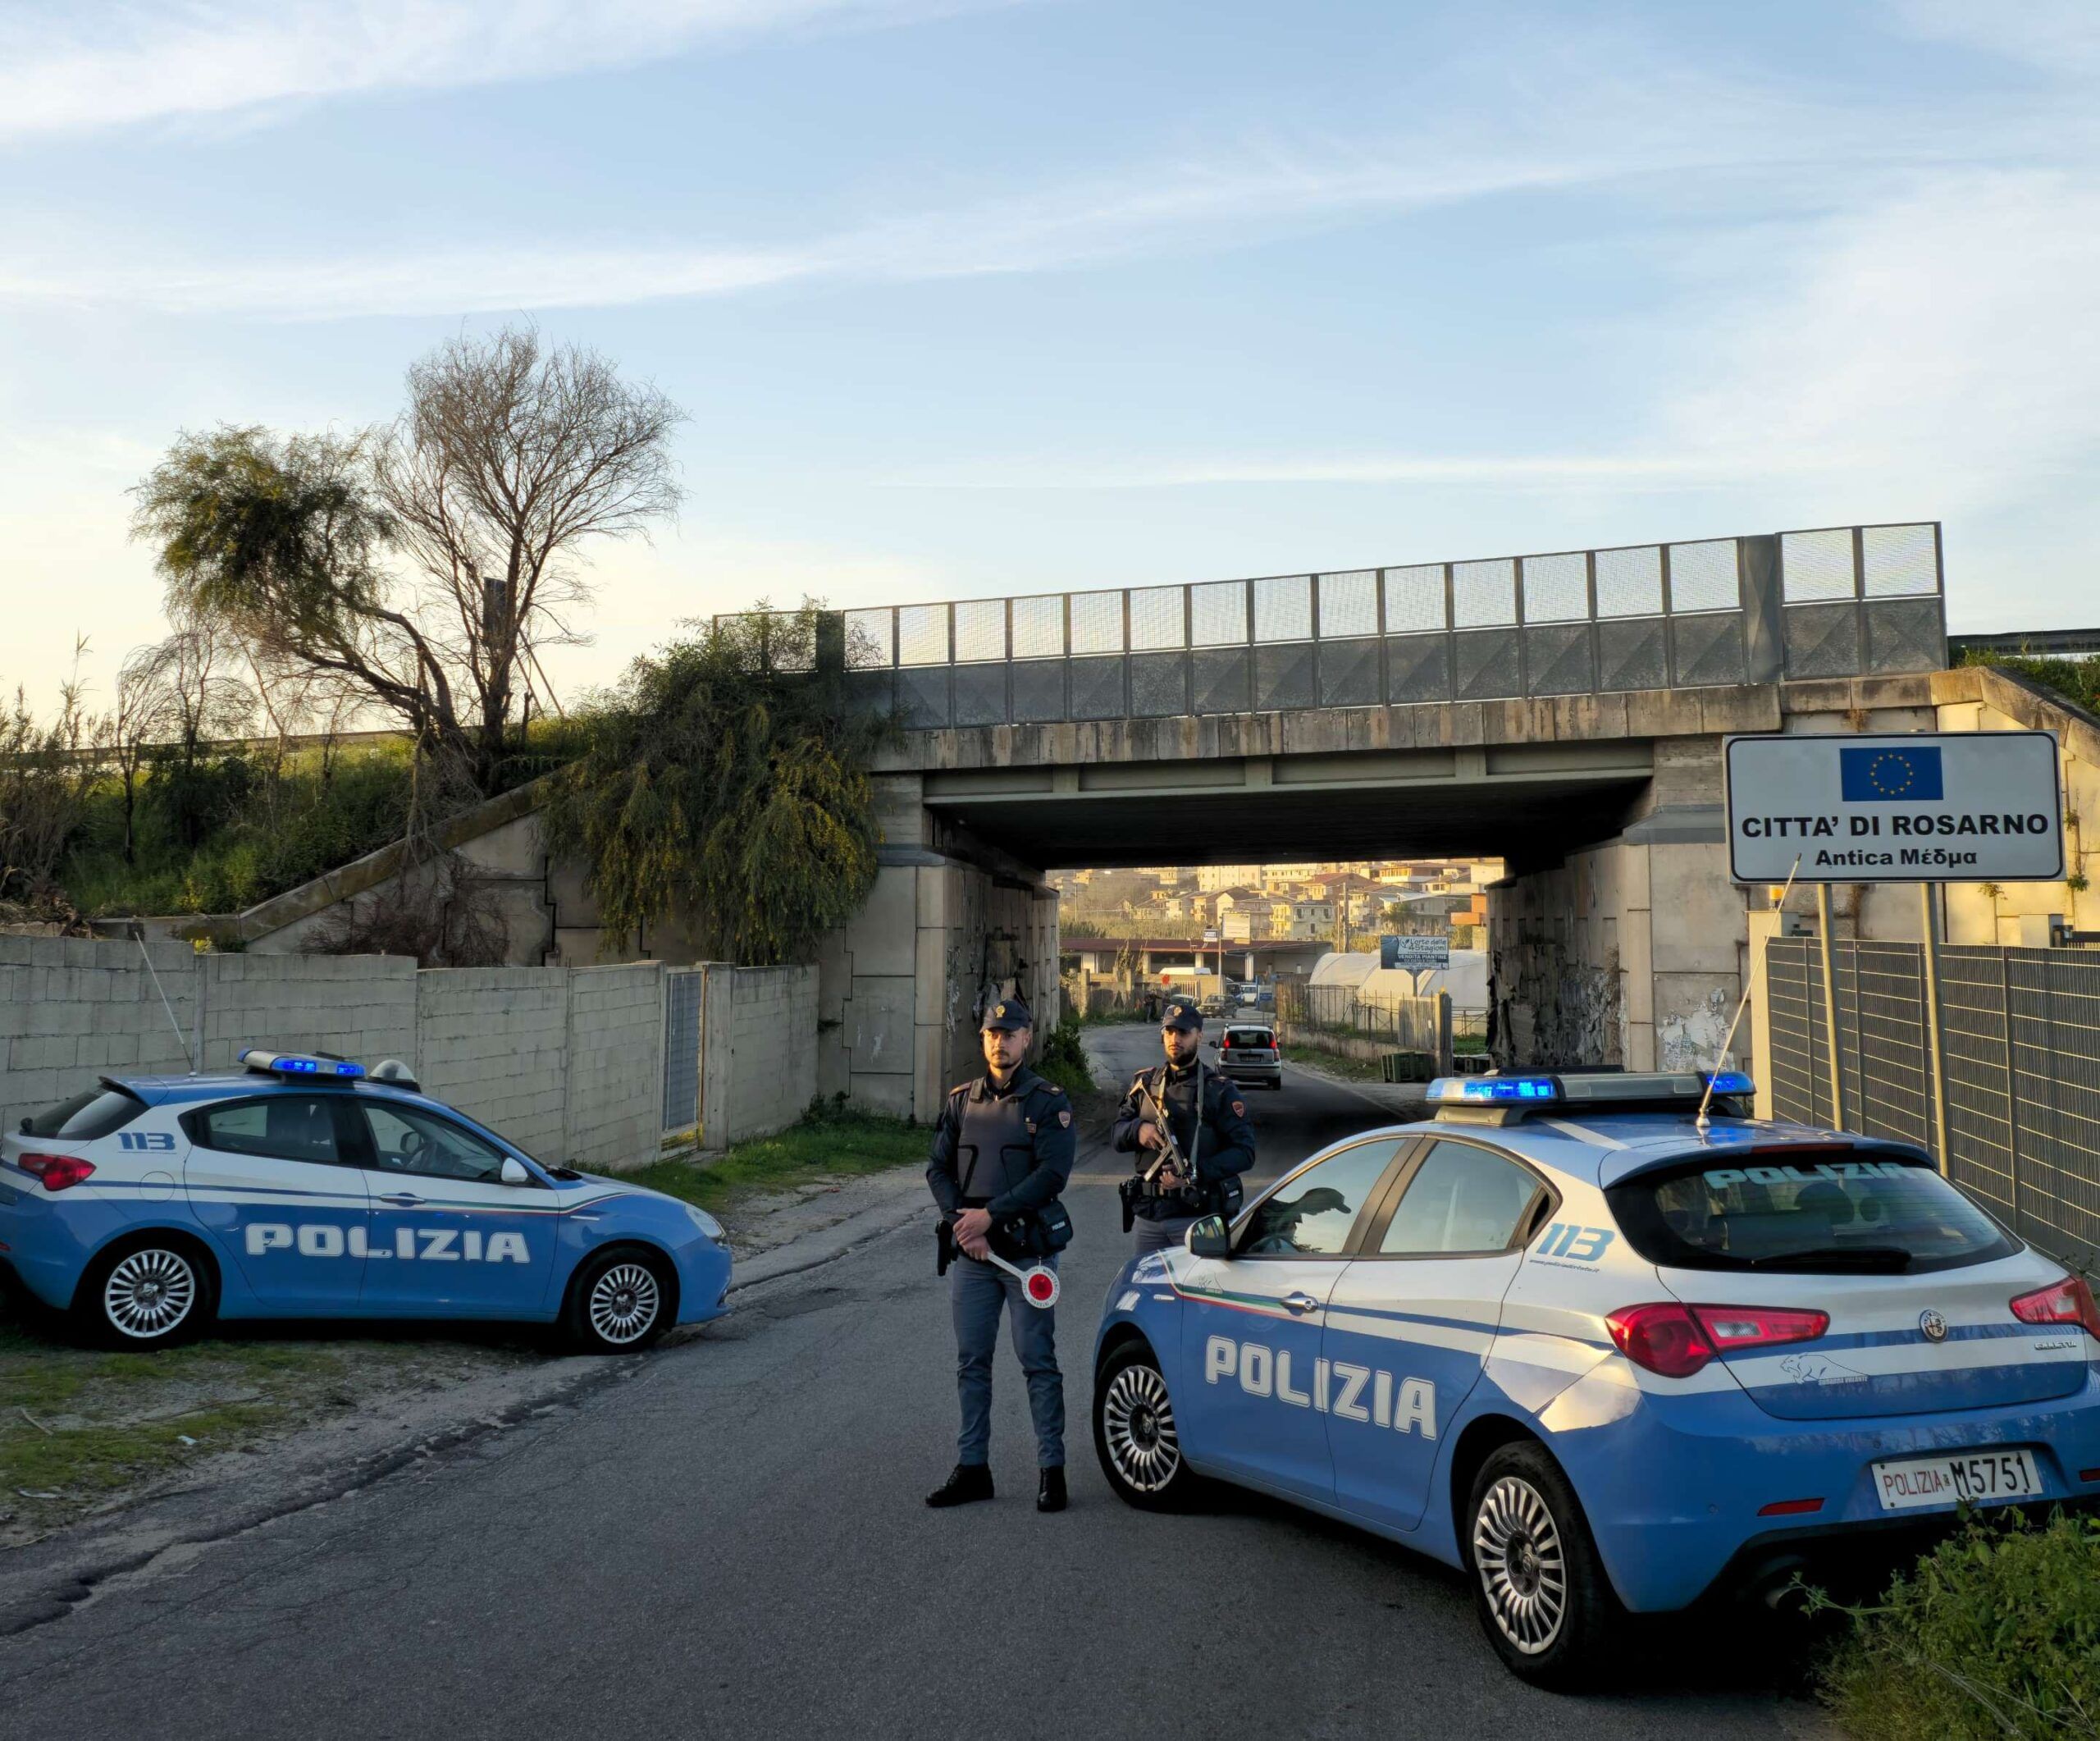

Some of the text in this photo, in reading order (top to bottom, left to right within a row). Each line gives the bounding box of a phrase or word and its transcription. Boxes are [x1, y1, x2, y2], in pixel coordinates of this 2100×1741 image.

[1850, 816, 1880, 836] DI
[1892, 813, 2049, 835] ROSARNO
[1815, 849, 1893, 866] Antica
[117, 1132, 176, 1150] 113
[1703, 1162, 1920, 1190] POLIZIA
[245, 1222, 531, 1263] POLIZIA
[1536, 1222, 1616, 1262] 113
[1204, 1335, 1438, 1441] POLIZIA
[1883, 1453, 2031, 1500] POLIZIA M5751
